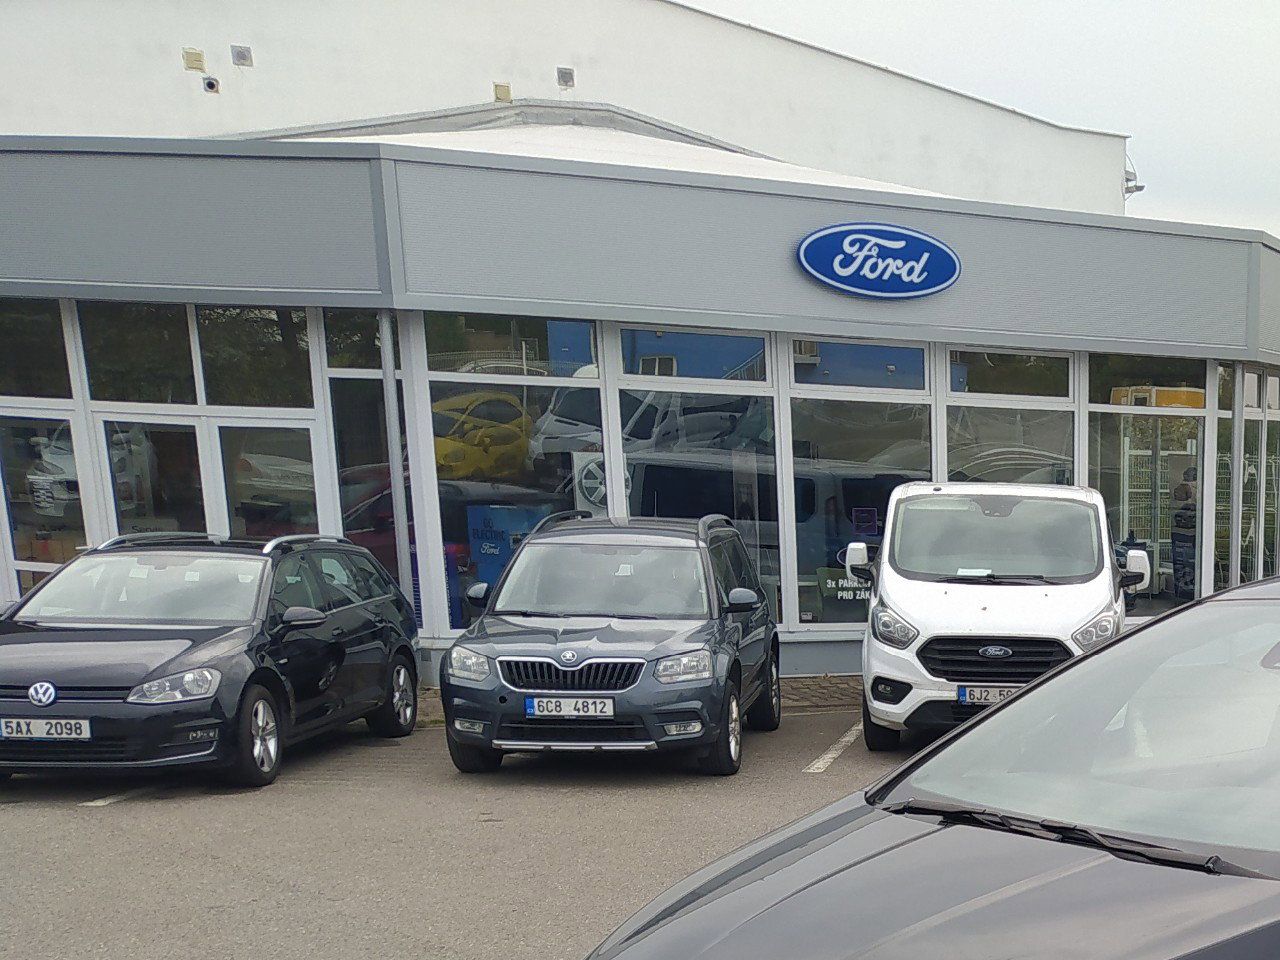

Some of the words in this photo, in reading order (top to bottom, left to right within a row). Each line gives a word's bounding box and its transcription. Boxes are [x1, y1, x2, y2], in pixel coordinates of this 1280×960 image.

[833, 234, 930, 283] Ford
[480, 542, 501, 555] Ford
[826, 580, 836, 588] 3x
[837, 591, 854, 600] PRO
[968, 689, 990, 701] 6J2
[537, 700, 562, 714] 6C8
[573, 700, 608, 714] 4812
[4, 720, 34, 736] 5AX
[44, 721, 83, 736] 2098
